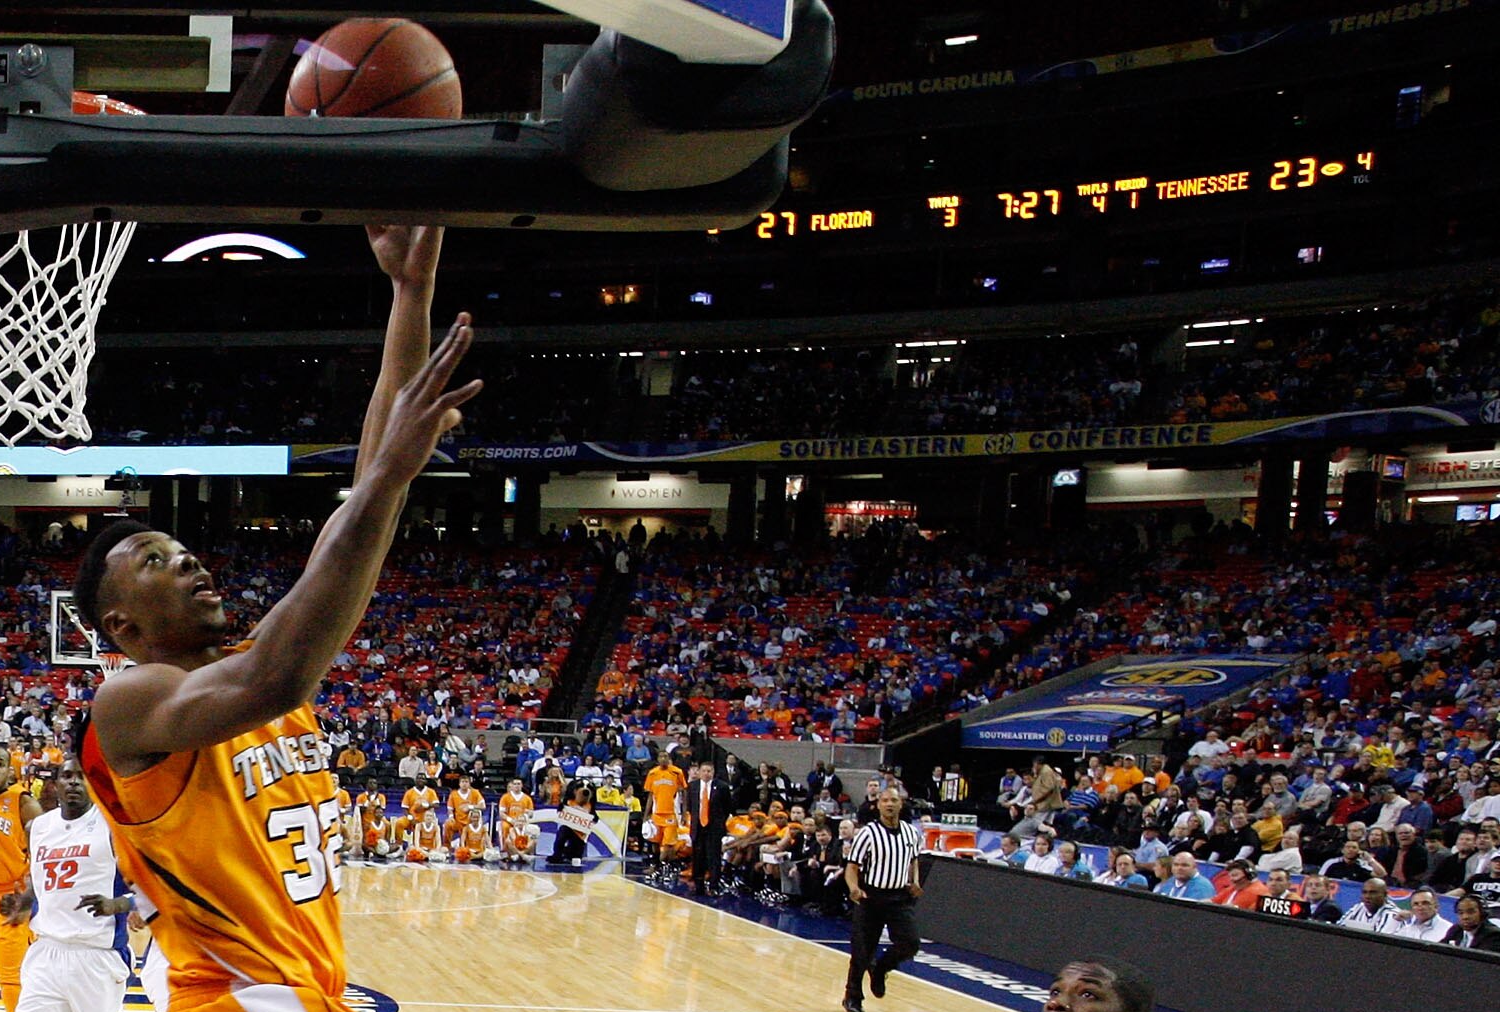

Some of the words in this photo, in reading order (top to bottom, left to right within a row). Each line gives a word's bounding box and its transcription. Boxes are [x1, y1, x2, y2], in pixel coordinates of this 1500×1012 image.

[852, 81, 914, 102] SOUTH
[918, 69, 1016, 95] CAROLINA
[1356, 152, 1373, 171] 4
[1269, 157, 1318, 191] 23
[1114, 177, 1148, 191] PERIOD
[1156, 172, 1250, 200] TENNESSEE
[998, 189, 1060, 219] 7:27
[1092, 195, 1106, 213] 4
[1130, 191, 1138, 209] 1
[757, 212, 796, 239] 27
[811, 210, 873, 231] FLORIDA
[943, 208, 956, 228] 3
[779, 436, 966, 458] SOUTHEASTERN
[1028, 425, 1213, 451] CONFERENCE
[458, 445, 578, 459] SECSPORTS.COM
[76, 488, 104, 497] MEN
[621, 488, 681, 498] WOMEN
[979, 731, 1045, 741] SOUTHEASTERN
[558, 810, 593, 829] DEFENSE
[36, 844, 91, 862] FLORIDA
[43, 860, 79, 891] 32
